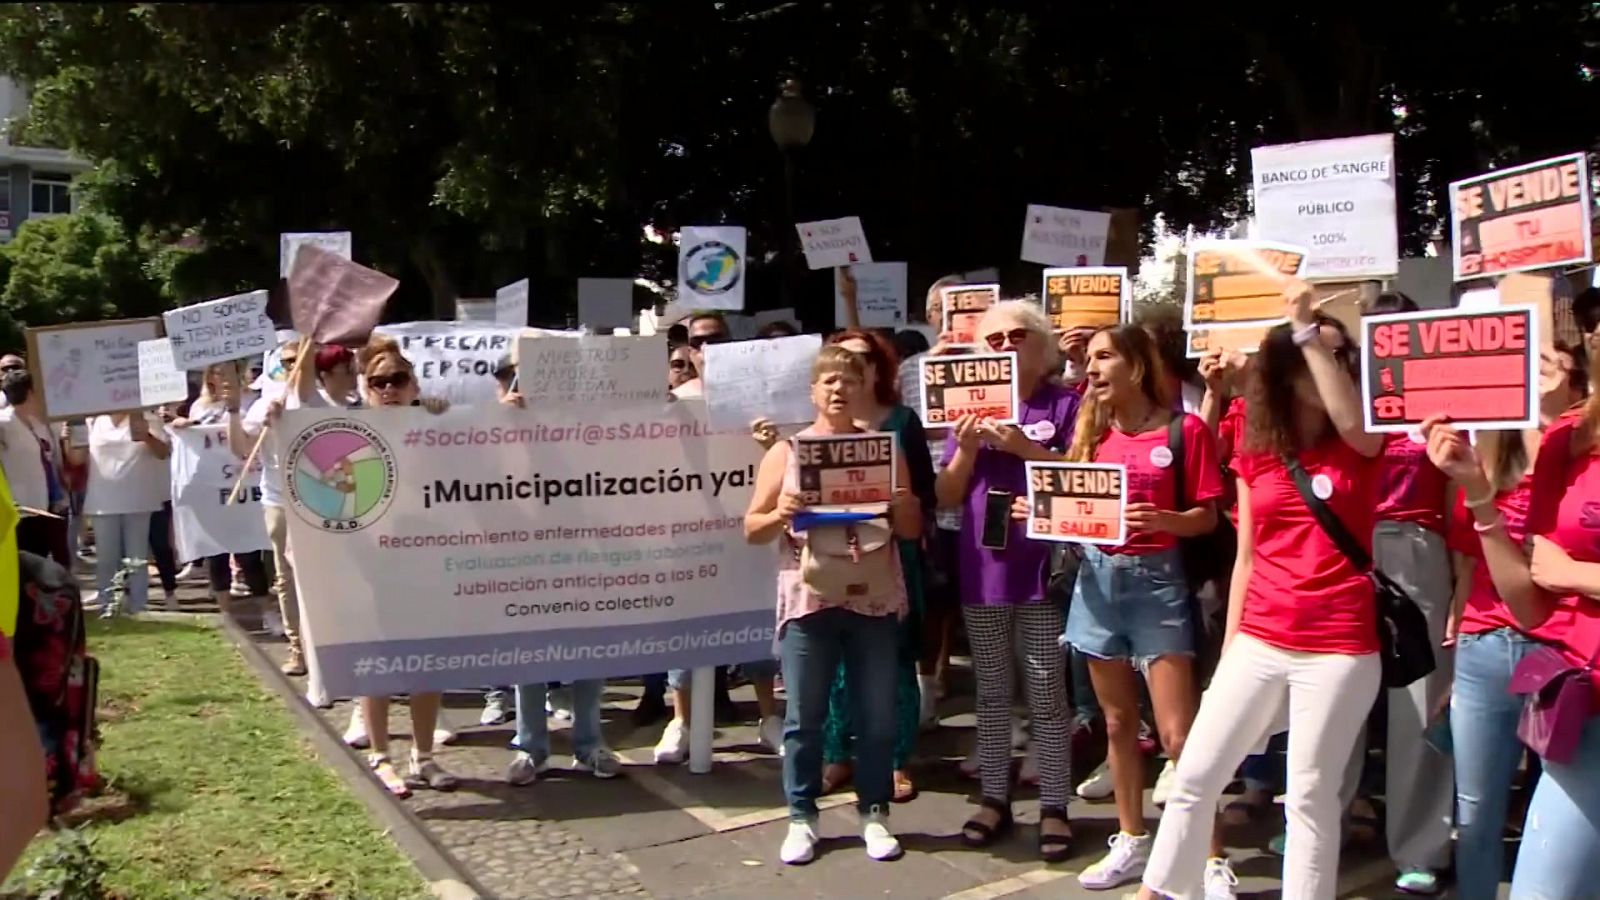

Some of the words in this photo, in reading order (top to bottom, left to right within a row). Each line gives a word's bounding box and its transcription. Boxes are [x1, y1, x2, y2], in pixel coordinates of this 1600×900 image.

[1261, 170, 1308, 183] BANCO
[1311, 167, 1329, 179] DE
[1332, 161, 1387, 175] SANGRE
[1456, 185, 1484, 220] SE
[1487, 161, 1580, 212] VENDE
[1312, 232, 1347, 245] 100%
[1514, 219, 1541, 240] TU
[1048, 277, 1068, 295] SE
[1070, 275, 1121, 294] VENDE
[182, 310, 200, 324] NO
[213, 297, 257, 318] SOMOS
[1373, 323, 1410, 358] SE
[1418, 315, 1526, 354] VENDE
[534, 364, 610, 380] MAYORES
[924, 363, 946, 386] SE
[951, 359, 1011, 384] VENDE
[968, 388, 987, 401] TU
[798, 443, 822, 466] SE
[829, 438, 891, 463] VENDE
[423, 467, 703, 508] ¡Municipalización
[711, 464, 754, 497] ya!
[846, 469, 867, 482] TU
[1032, 469, 1054, 492] SE
[1059, 470, 1121, 495] VENDE
[1076, 501, 1094, 515] TU
[379, 529, 530, 549] Reconocimiento
[534, 523, 666, 542] enfermedades
[1059, 521, 1108, 538] SALUD
[550, 551, 575, 565] de
[453, 575, 548, 597] Jubilación
[551, 572, 650, 591] anticipada
[655, 574, 667, 584] a
[671, 569, 694, 583] los
[698, 563, 718, 578] 60
[504, 598, 590, 617] Convenio
[594, 594, 675, 612] colectivo
[352, 626, 775, 677] #SADEsencialesNuncaMásOlvidadas
